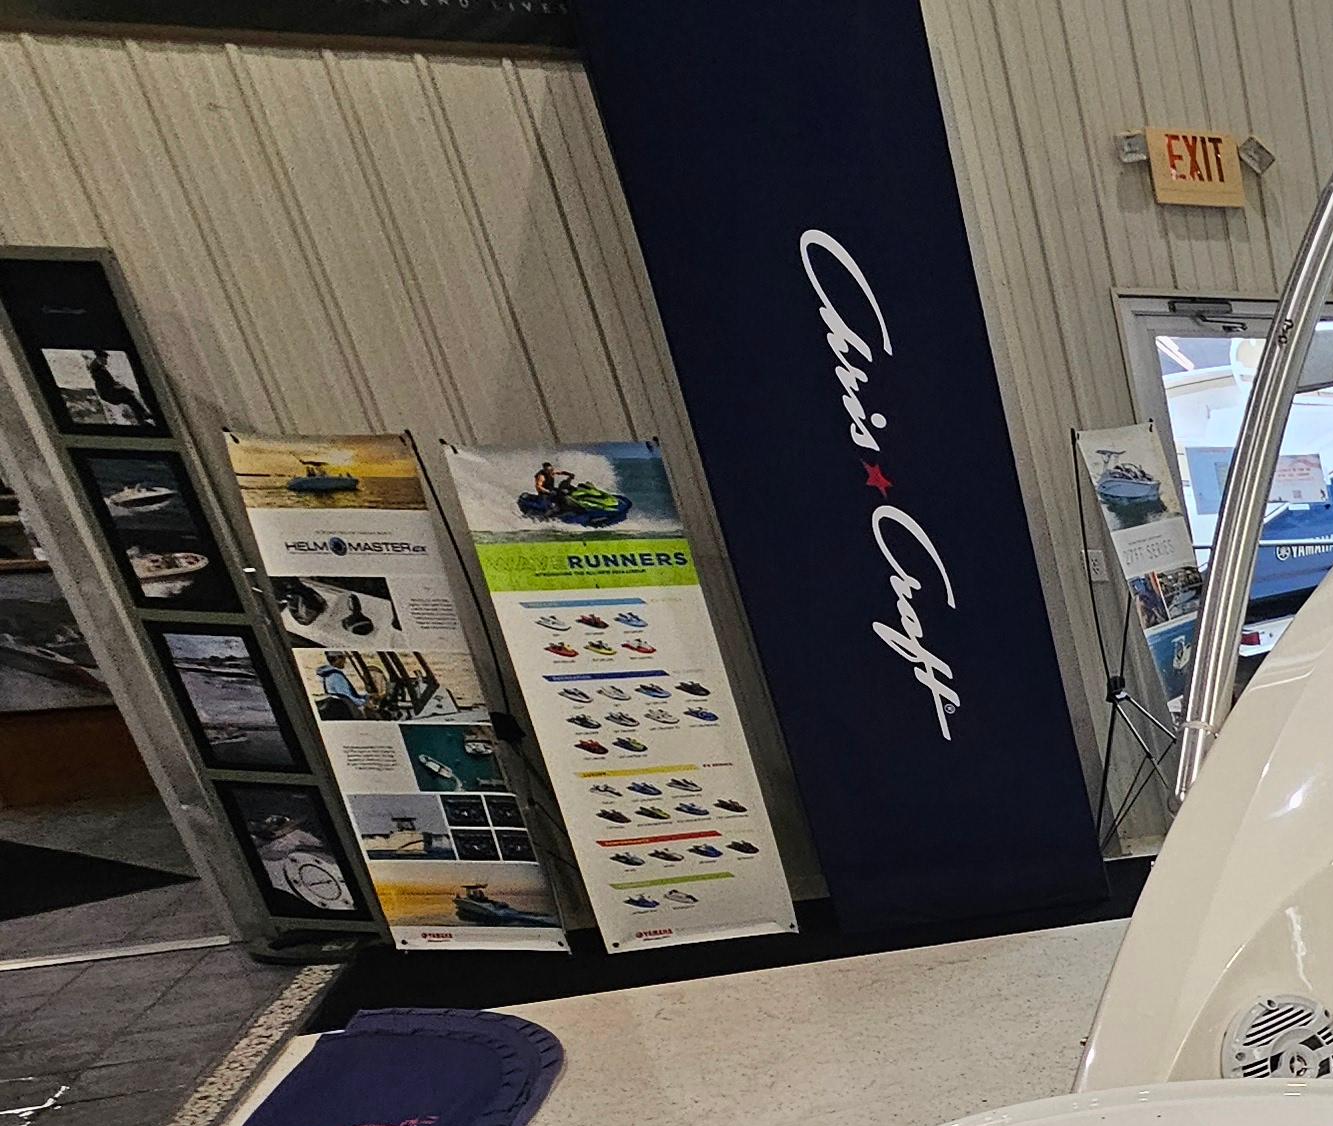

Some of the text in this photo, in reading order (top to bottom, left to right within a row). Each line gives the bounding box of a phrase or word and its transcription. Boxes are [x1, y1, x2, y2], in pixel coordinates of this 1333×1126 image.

[1164, 133, 1225, 183] EXIT
[800, 229, 960, 741] Chris Craft
[284, 541, 329, 552] HELM
[347, 542, 411, 553] MASTER
